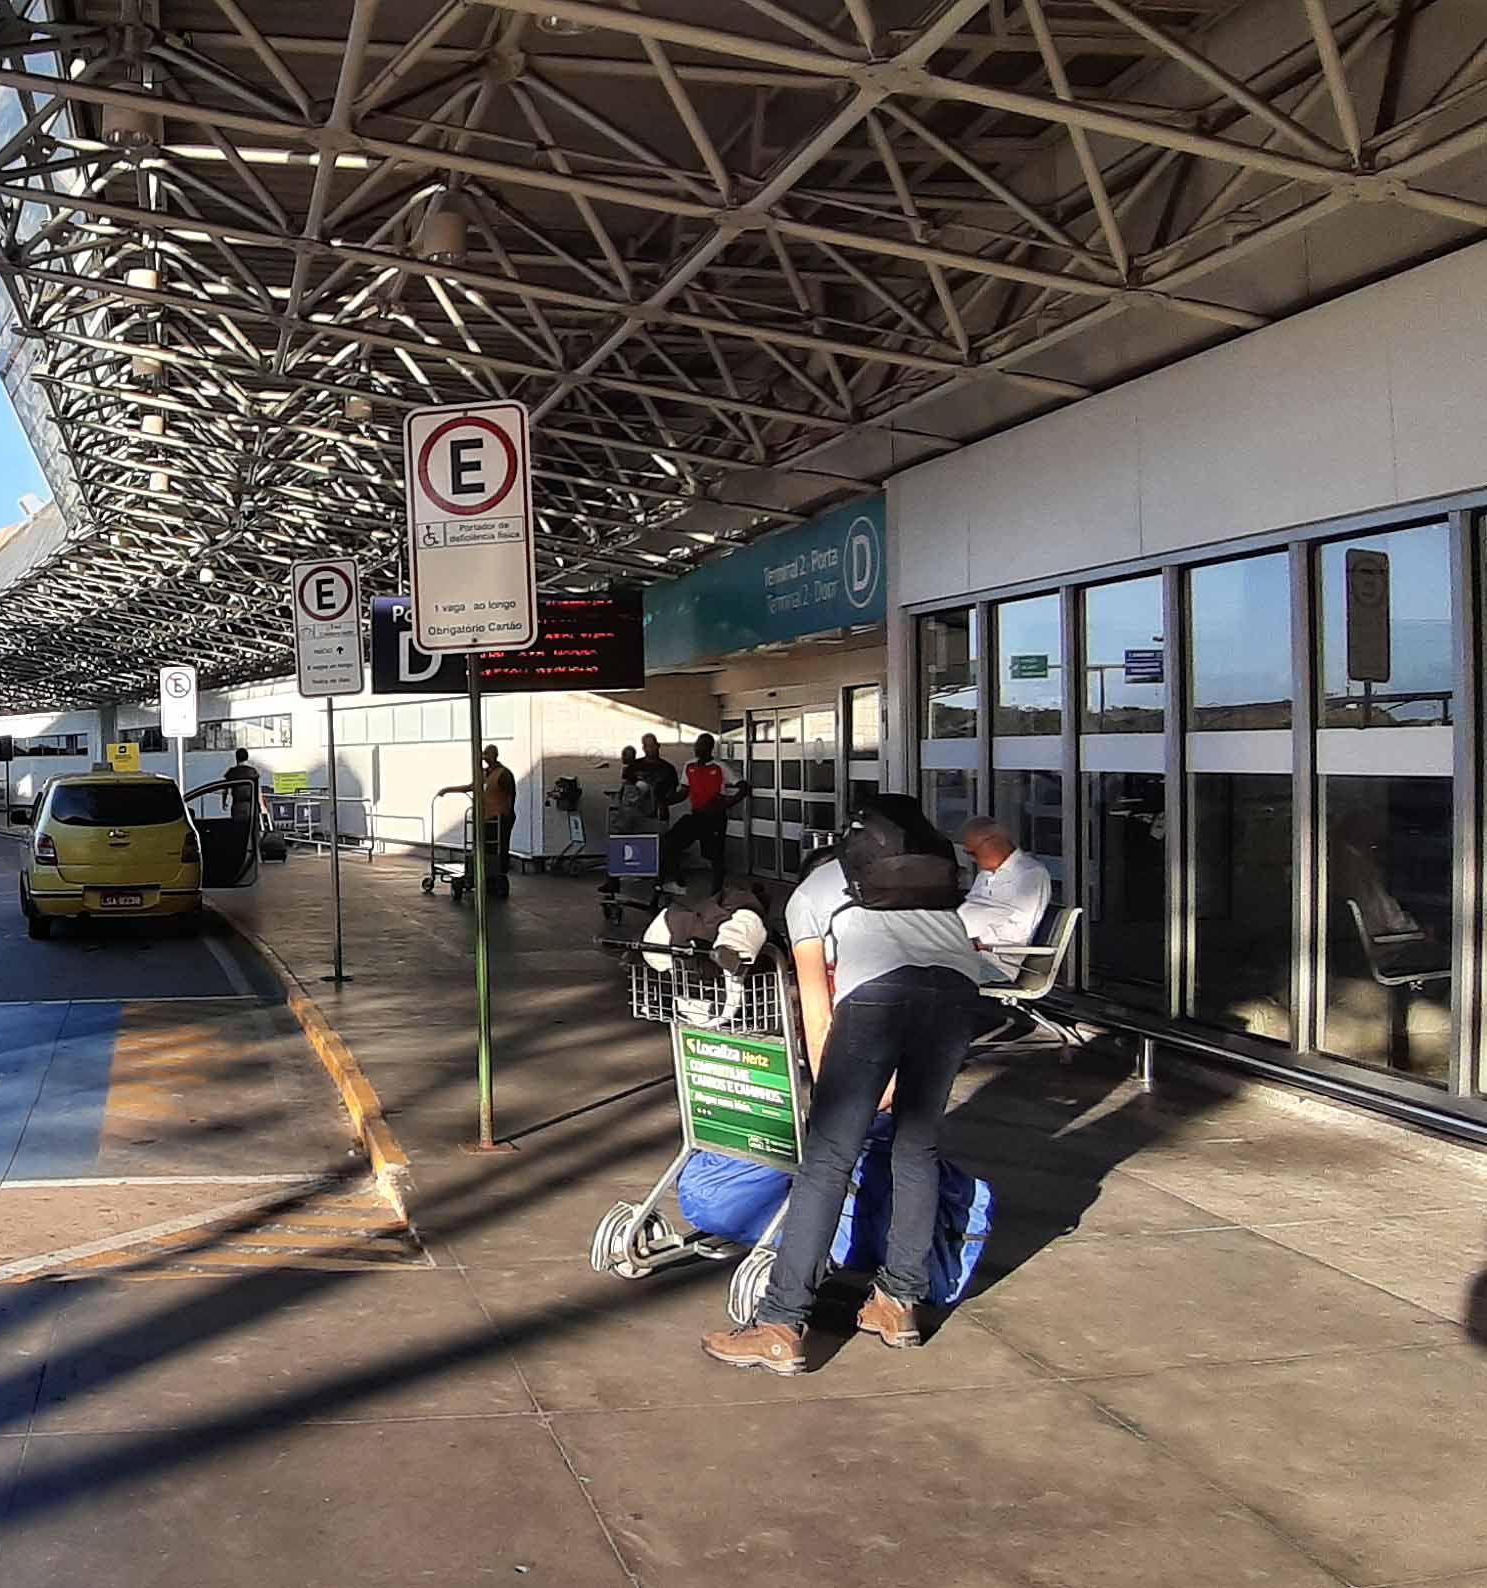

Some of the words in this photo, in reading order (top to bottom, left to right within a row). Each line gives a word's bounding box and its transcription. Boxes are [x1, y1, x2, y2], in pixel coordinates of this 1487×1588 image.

[450, 438, 485, 495] E
[811, 548, 838, 572] Porta
[853, 535, 871, 591] D
[316, 578, 336, 610] E
[474, 602, 486, 610] ao
[488, 600, 516, 610] longo
[398, 631, 442, 682] D
[696, 1039, 740, 1062] Localiza
[742, 1050, 770, 1068] Hertz
